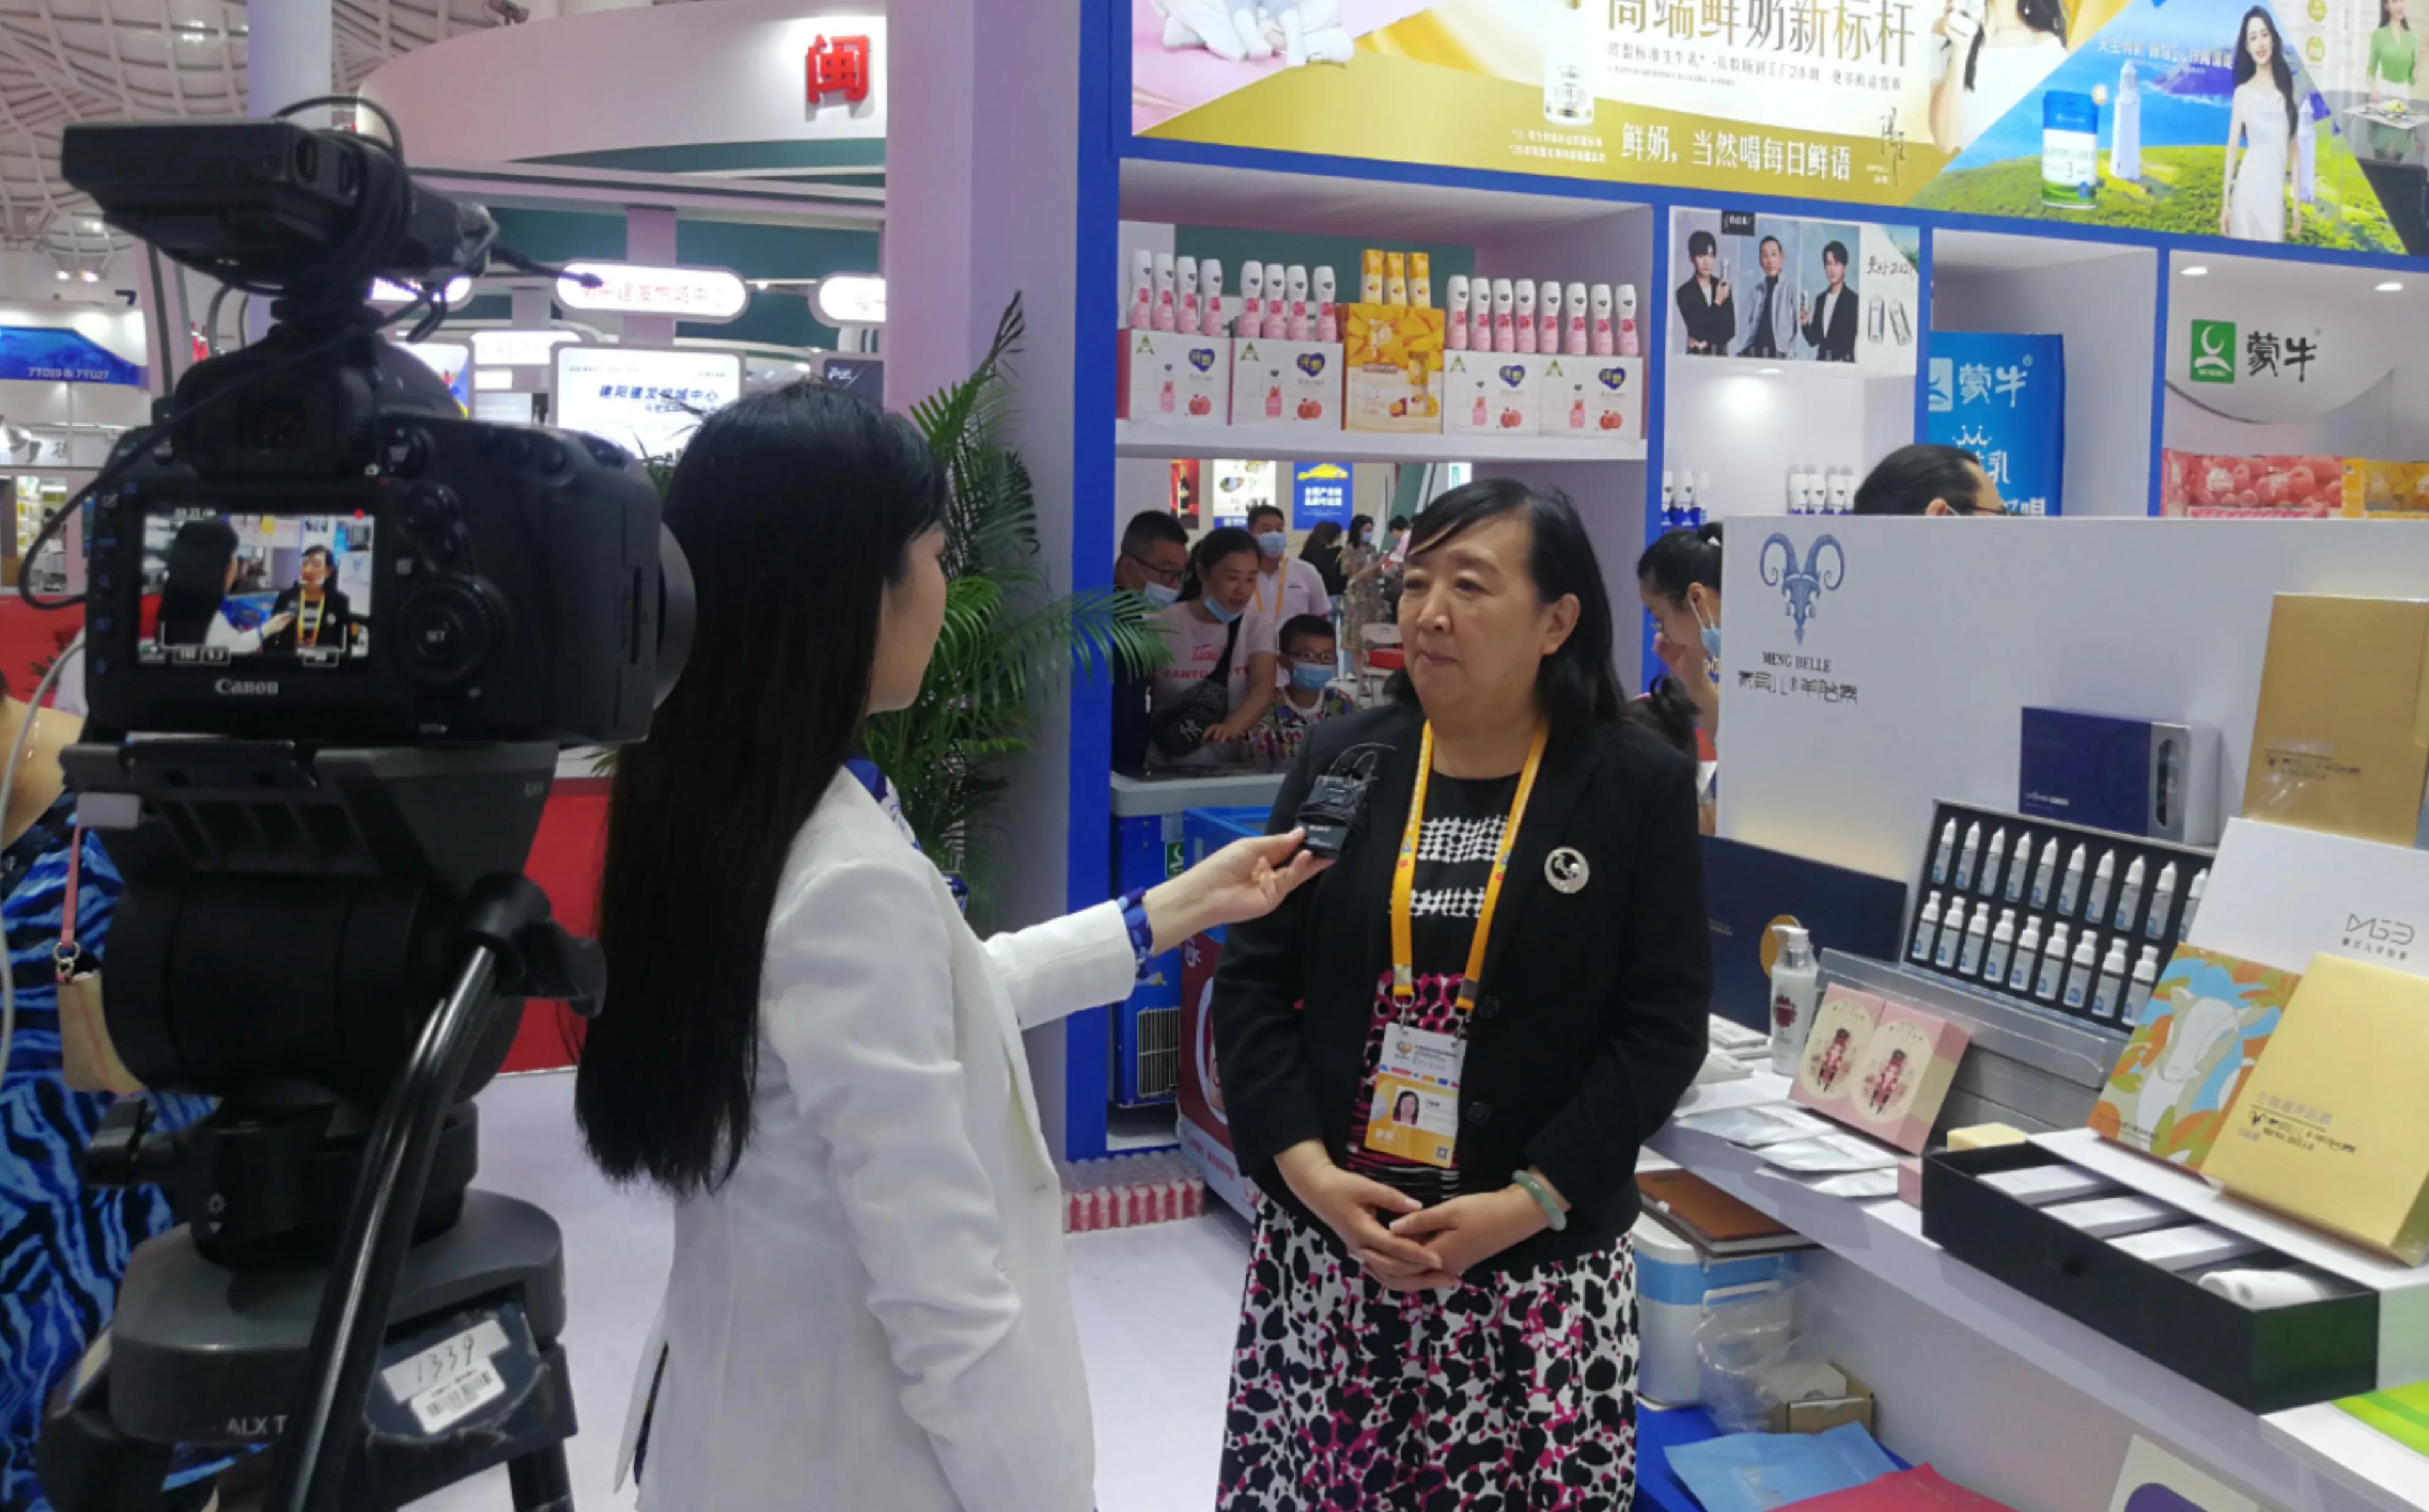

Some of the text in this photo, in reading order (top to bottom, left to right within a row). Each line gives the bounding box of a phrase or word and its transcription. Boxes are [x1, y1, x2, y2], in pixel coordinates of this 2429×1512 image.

[806, 34, 870, 104] 闽
[2246, 331, 2317, 383] 蒙牛
[1958, 363, 2027, 408] 蒙牛
[1762, 651, 1832, 674] MENG BELLE
[214, 678, 279, 695] Canon
[226, 1415, 269, 1435] ALX
